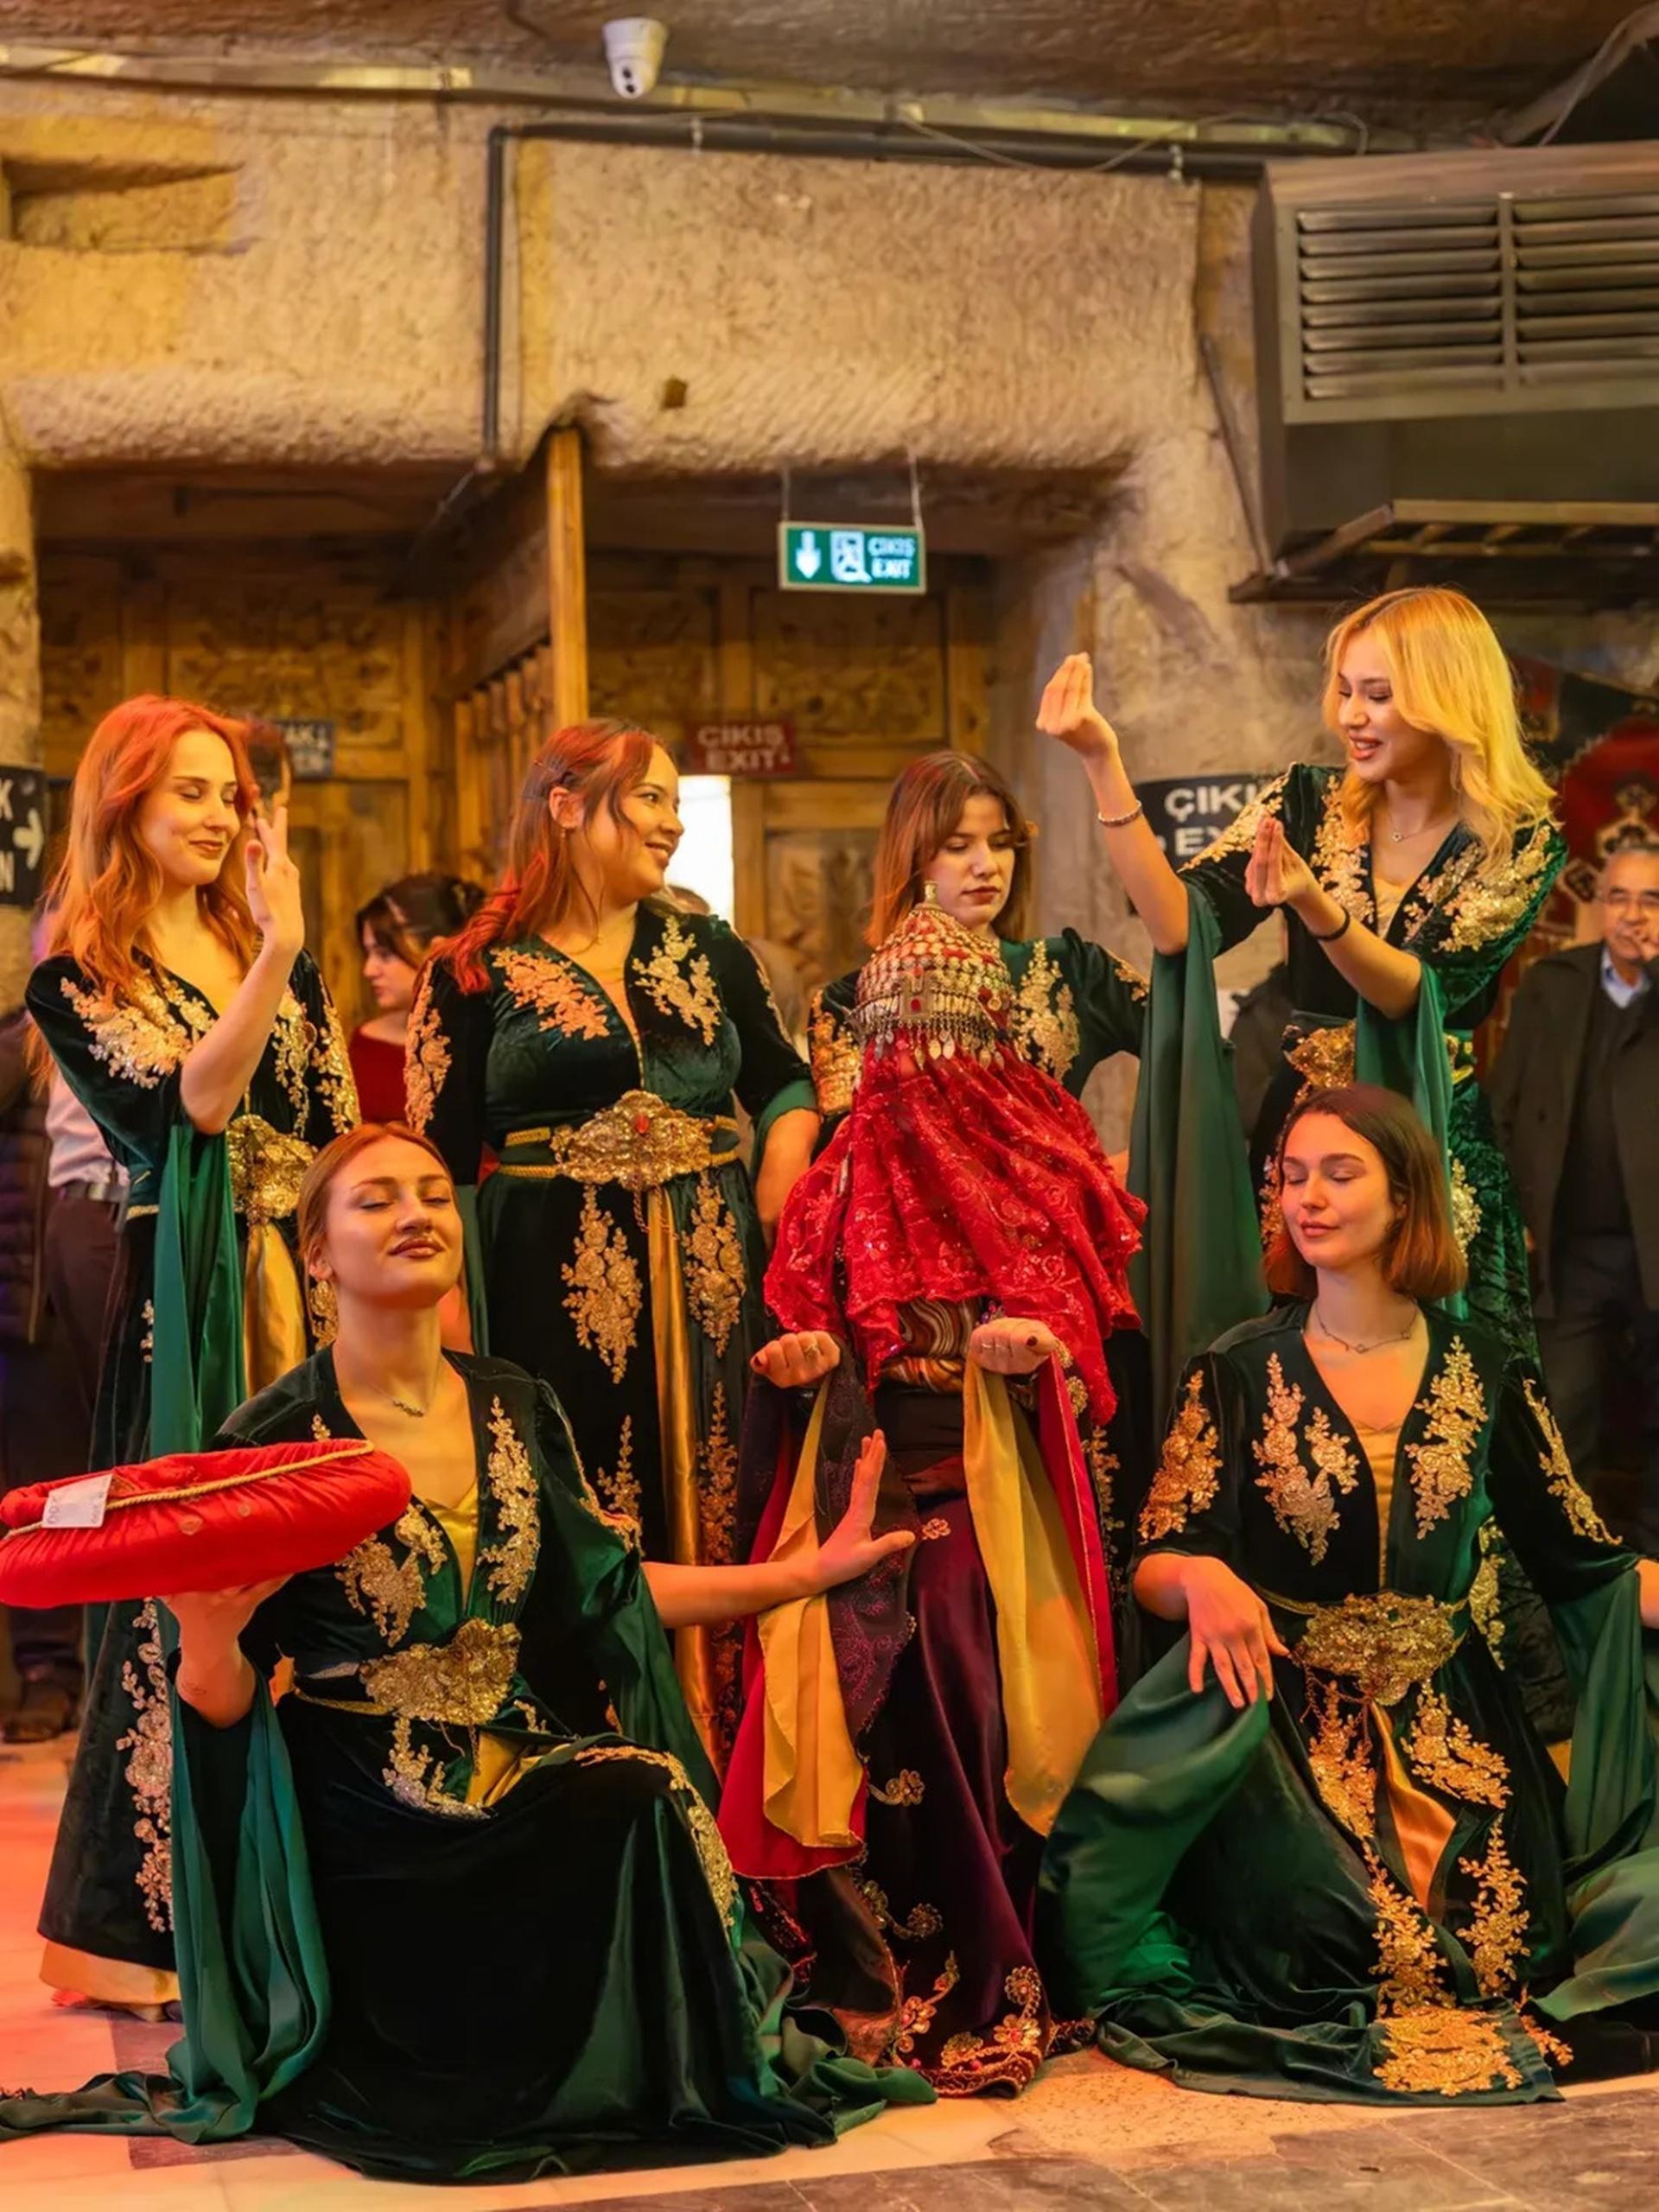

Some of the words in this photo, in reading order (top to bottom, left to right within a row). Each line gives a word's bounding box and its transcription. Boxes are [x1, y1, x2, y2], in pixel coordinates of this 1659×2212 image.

[871, 557, 912, 580] EXIT
[705, 748, 775, 772] EXIT
[1164, 783, 1259, 823] ÇIKI
